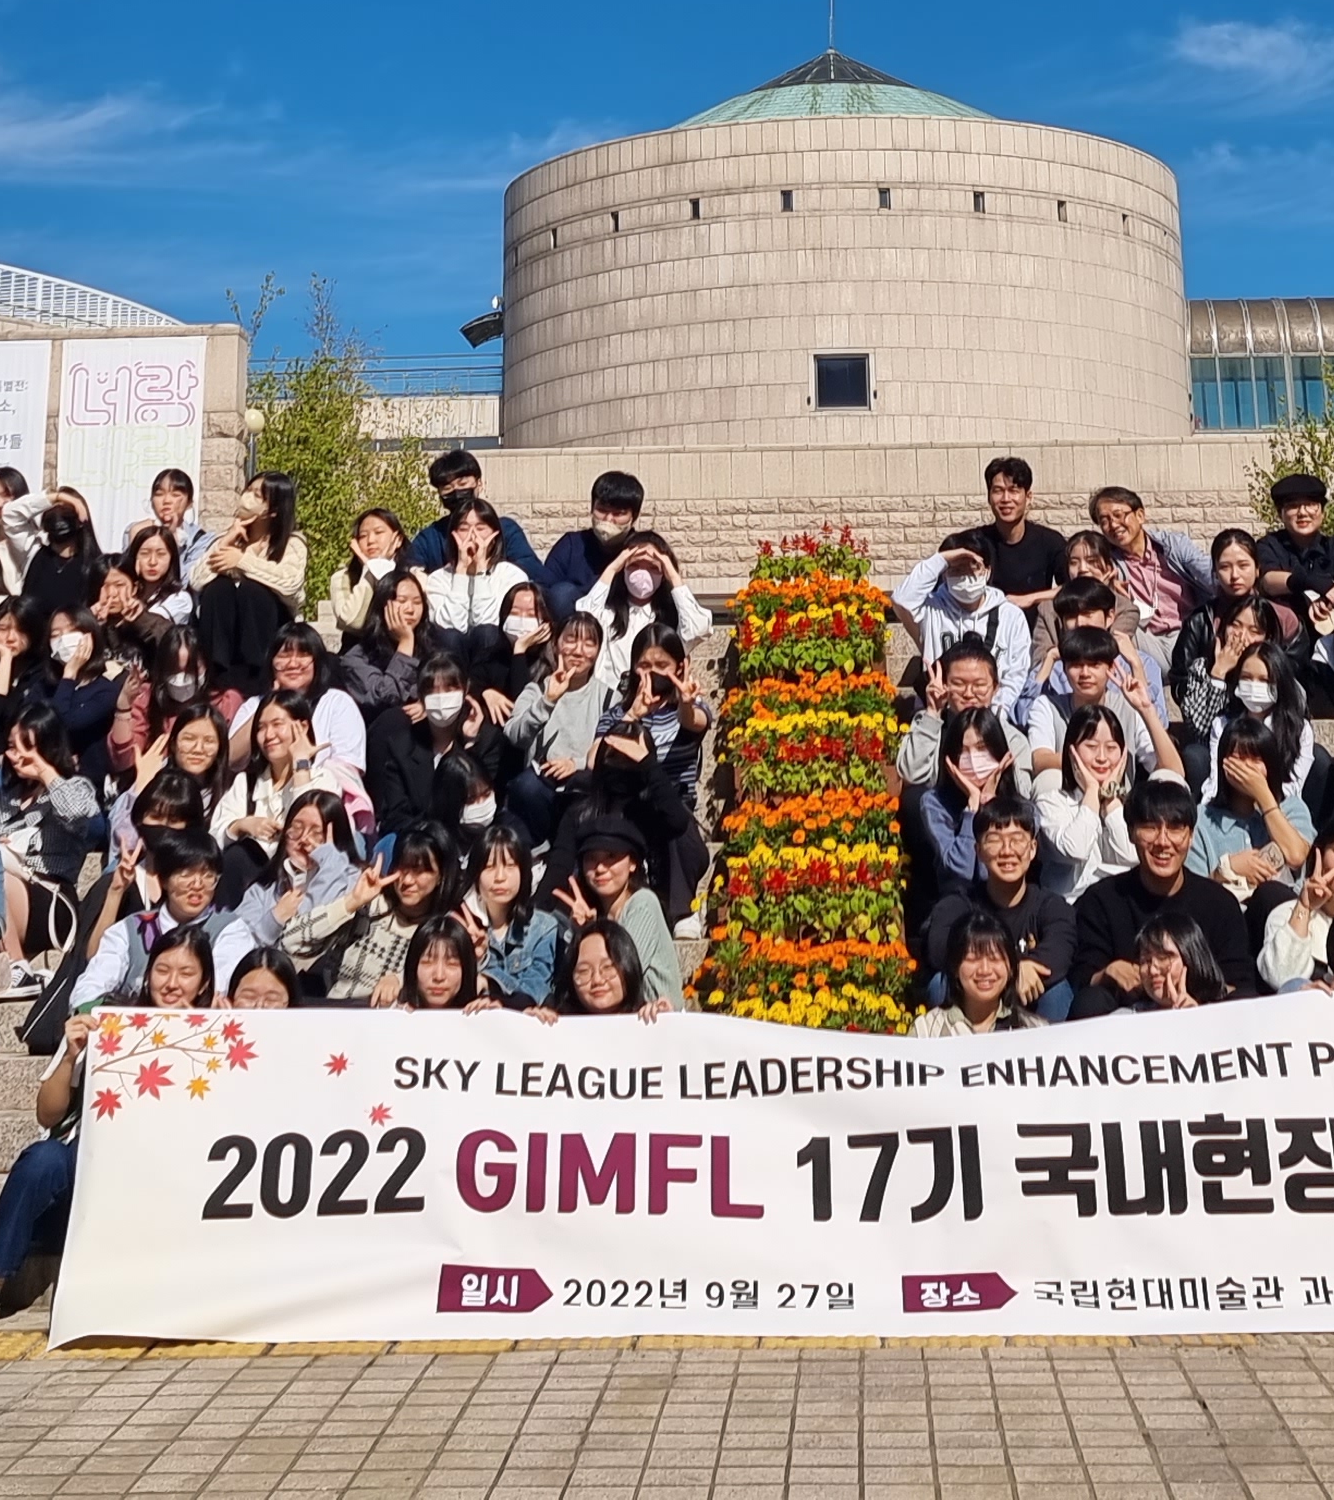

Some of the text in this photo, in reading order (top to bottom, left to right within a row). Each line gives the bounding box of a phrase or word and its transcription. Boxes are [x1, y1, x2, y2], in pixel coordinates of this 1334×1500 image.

[66, 360, 199, 427] 너랑
[394, 1056, 481, 1092] SKY
[495, 1062, 663, 1100] LEAGUE
[679, 1056, 945, 1100] LEADERSHIP
[960, 1042, 1292, 1088] ENHANCEMENT
[201, 1126, 427, 1220] 2022
[455, 1129, 765, 1219] GIMFL
[796, 1124, 984, 1224] 17기
[460, 1273, 854, 1310] 일시 2022년 9월 27일
[919, 1282, 982, 1311] 장소
[1034, 1276, 1284, 1311] 국립현대미술관
